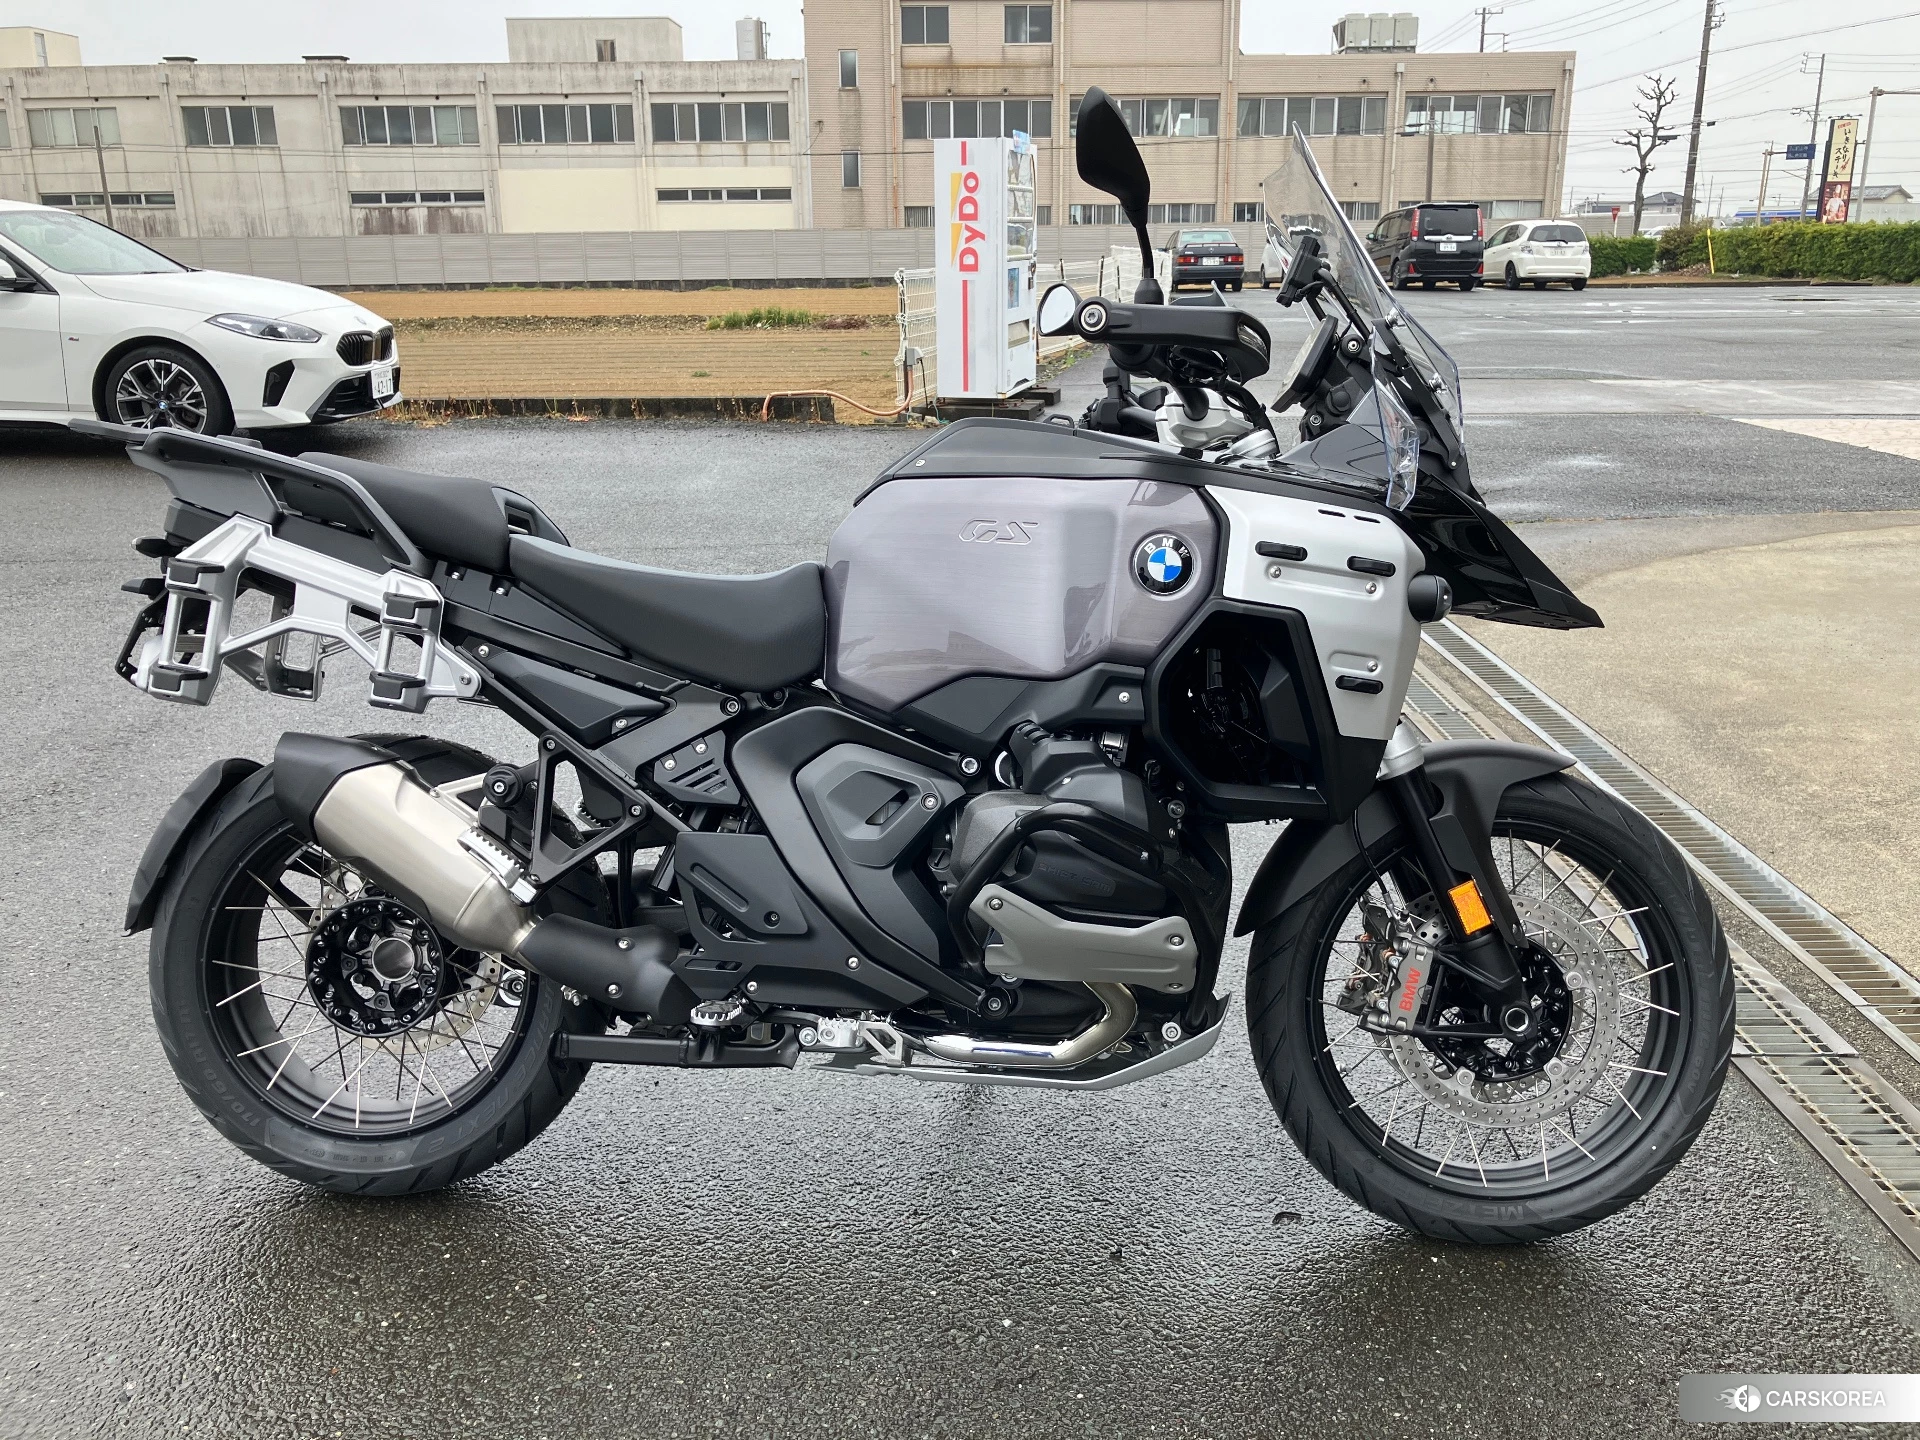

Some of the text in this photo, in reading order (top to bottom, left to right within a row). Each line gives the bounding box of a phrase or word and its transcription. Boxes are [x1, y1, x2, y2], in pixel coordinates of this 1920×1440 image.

[959, 172, 986, 272] DyDo
[958, 519, 1040, 545] GS
[1144, 537, 1191, 559] BMW
[1398, 966, 1422, 1012] BMW
